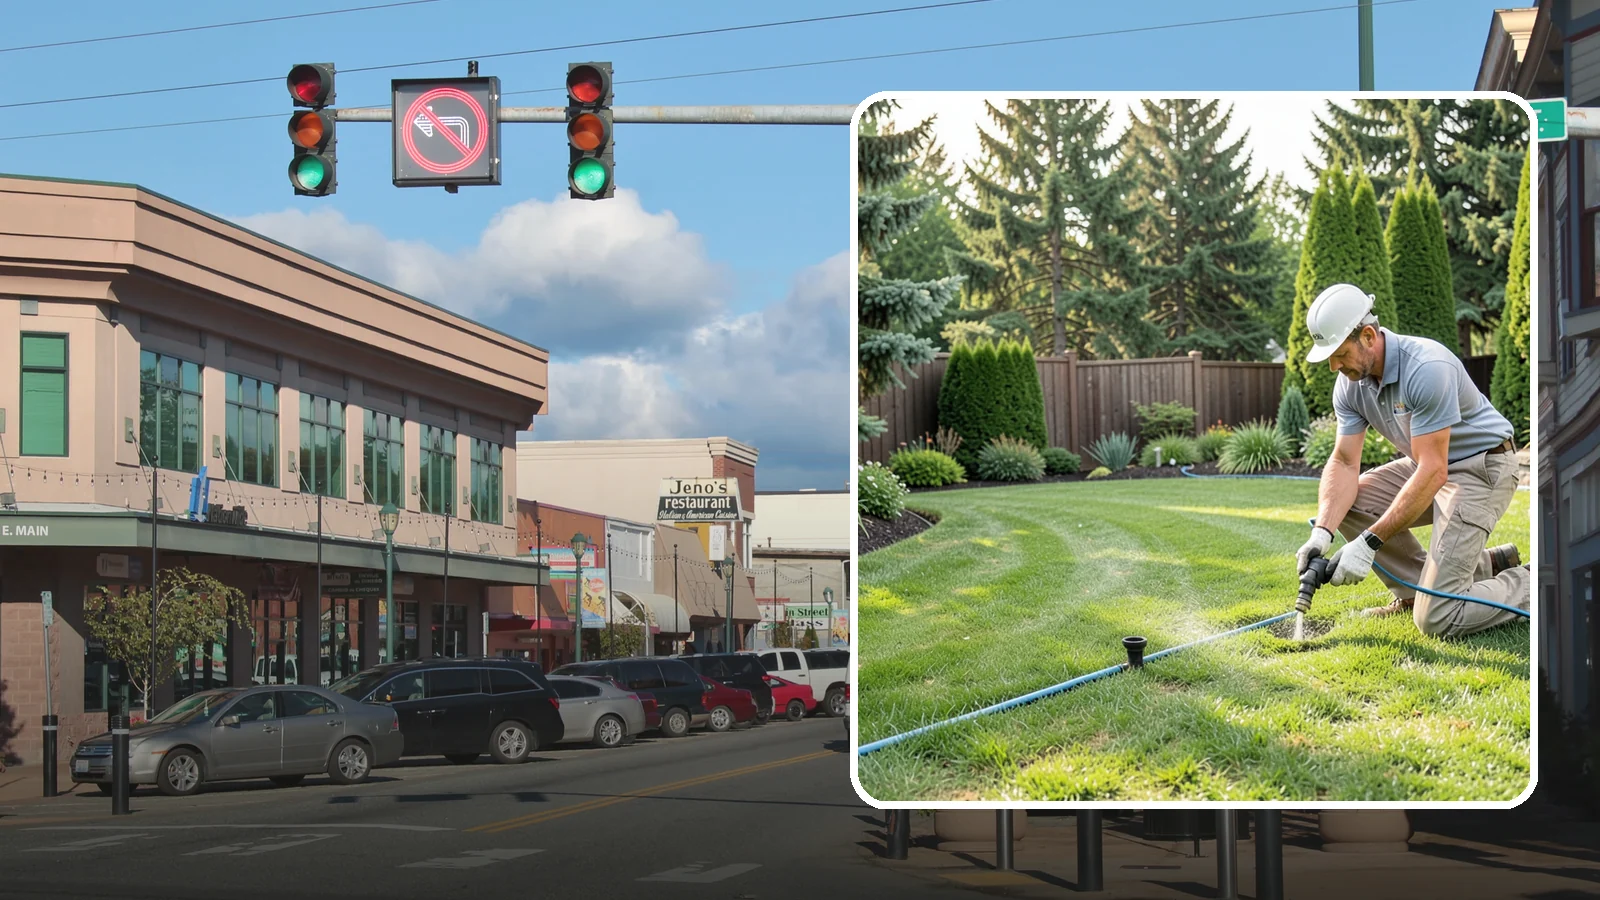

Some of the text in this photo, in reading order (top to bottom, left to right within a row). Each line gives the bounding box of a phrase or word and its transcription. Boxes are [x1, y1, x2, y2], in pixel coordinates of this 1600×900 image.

[670, 480, 728, 495] Jeno's
[665, 496, 731, 509] restaurant
[658, 510, 681, 520] Italian
[686, 510, 715, 520] American
[715, 509, 737, 520] Cuisine
[2, 525, 49, 537] E. MAIN
[797, 608, 829, 617] Street
[791, 619, 823, 627] lass
